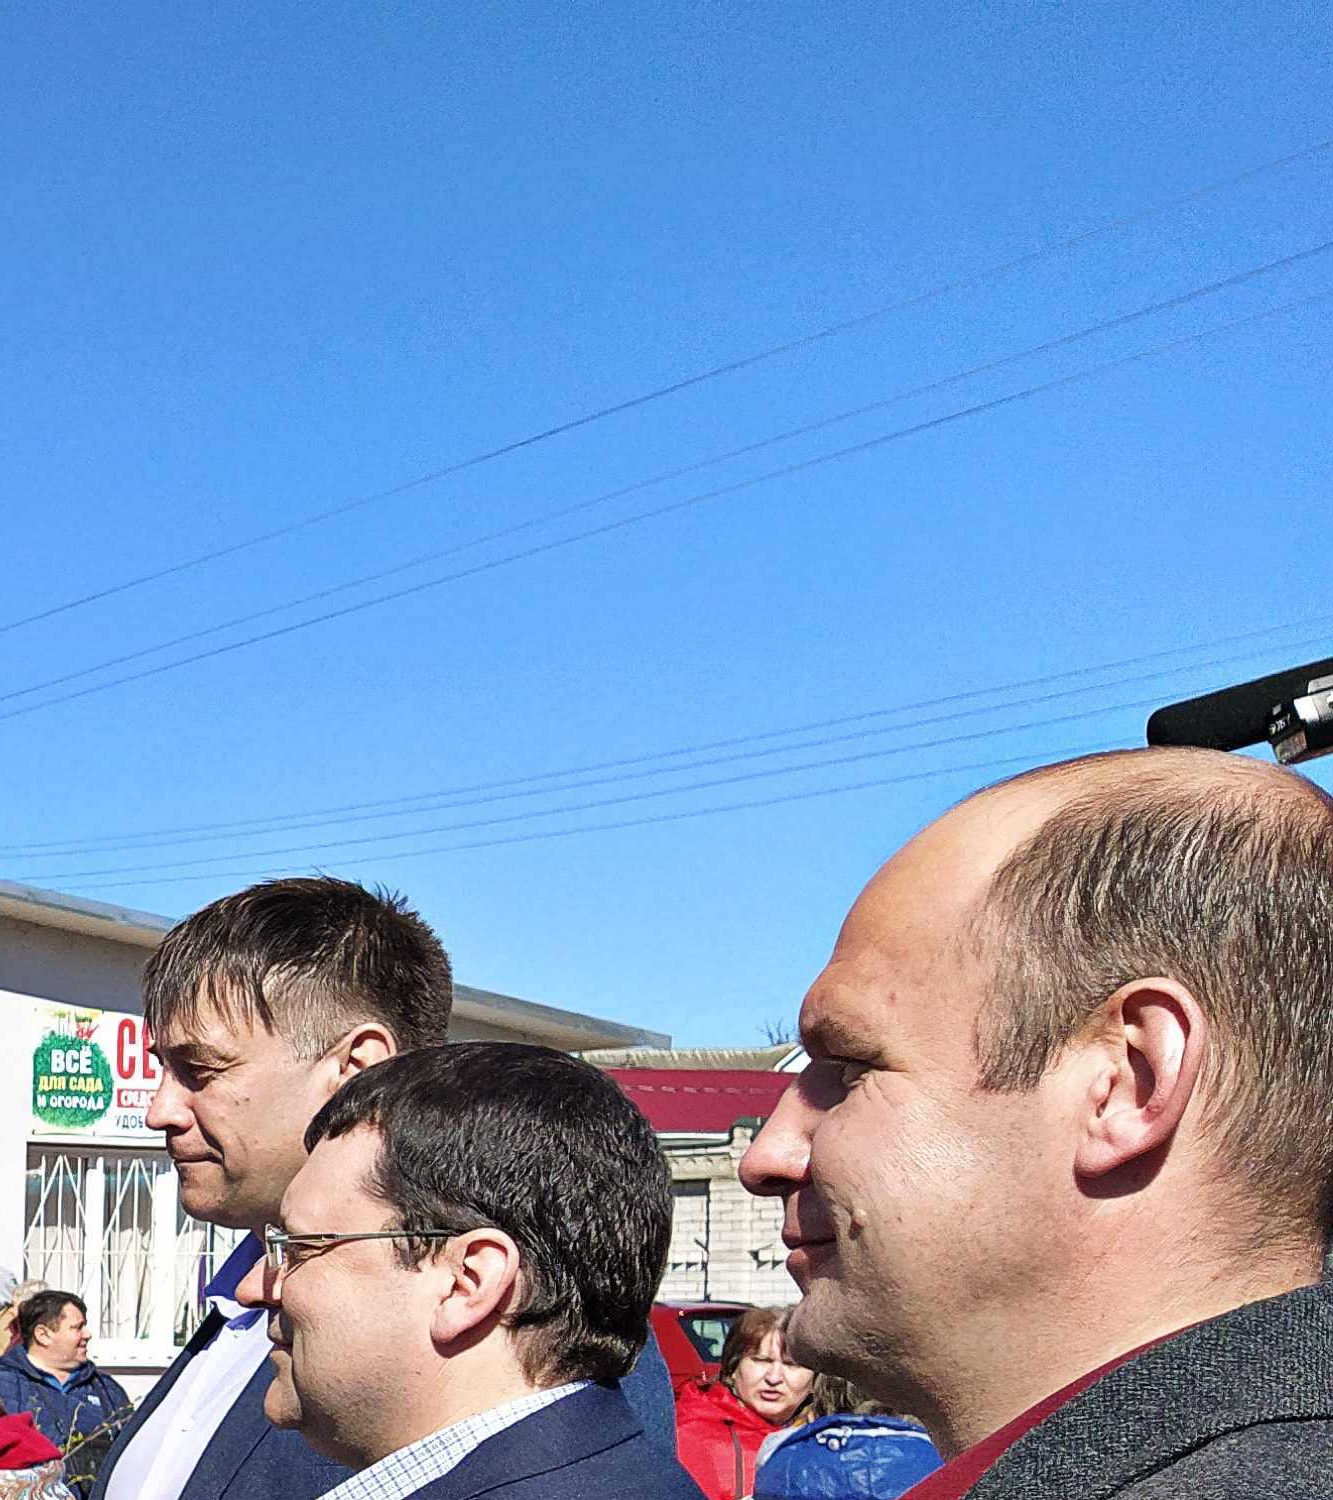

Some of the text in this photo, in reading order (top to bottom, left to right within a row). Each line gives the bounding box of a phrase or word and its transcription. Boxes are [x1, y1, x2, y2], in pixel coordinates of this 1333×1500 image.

[51, 1045, 93, 1074] ВСЁ
[69, 1076, 104, 1093] САДА
[37, 1094, 105, 1111] И ОГОРОДА
